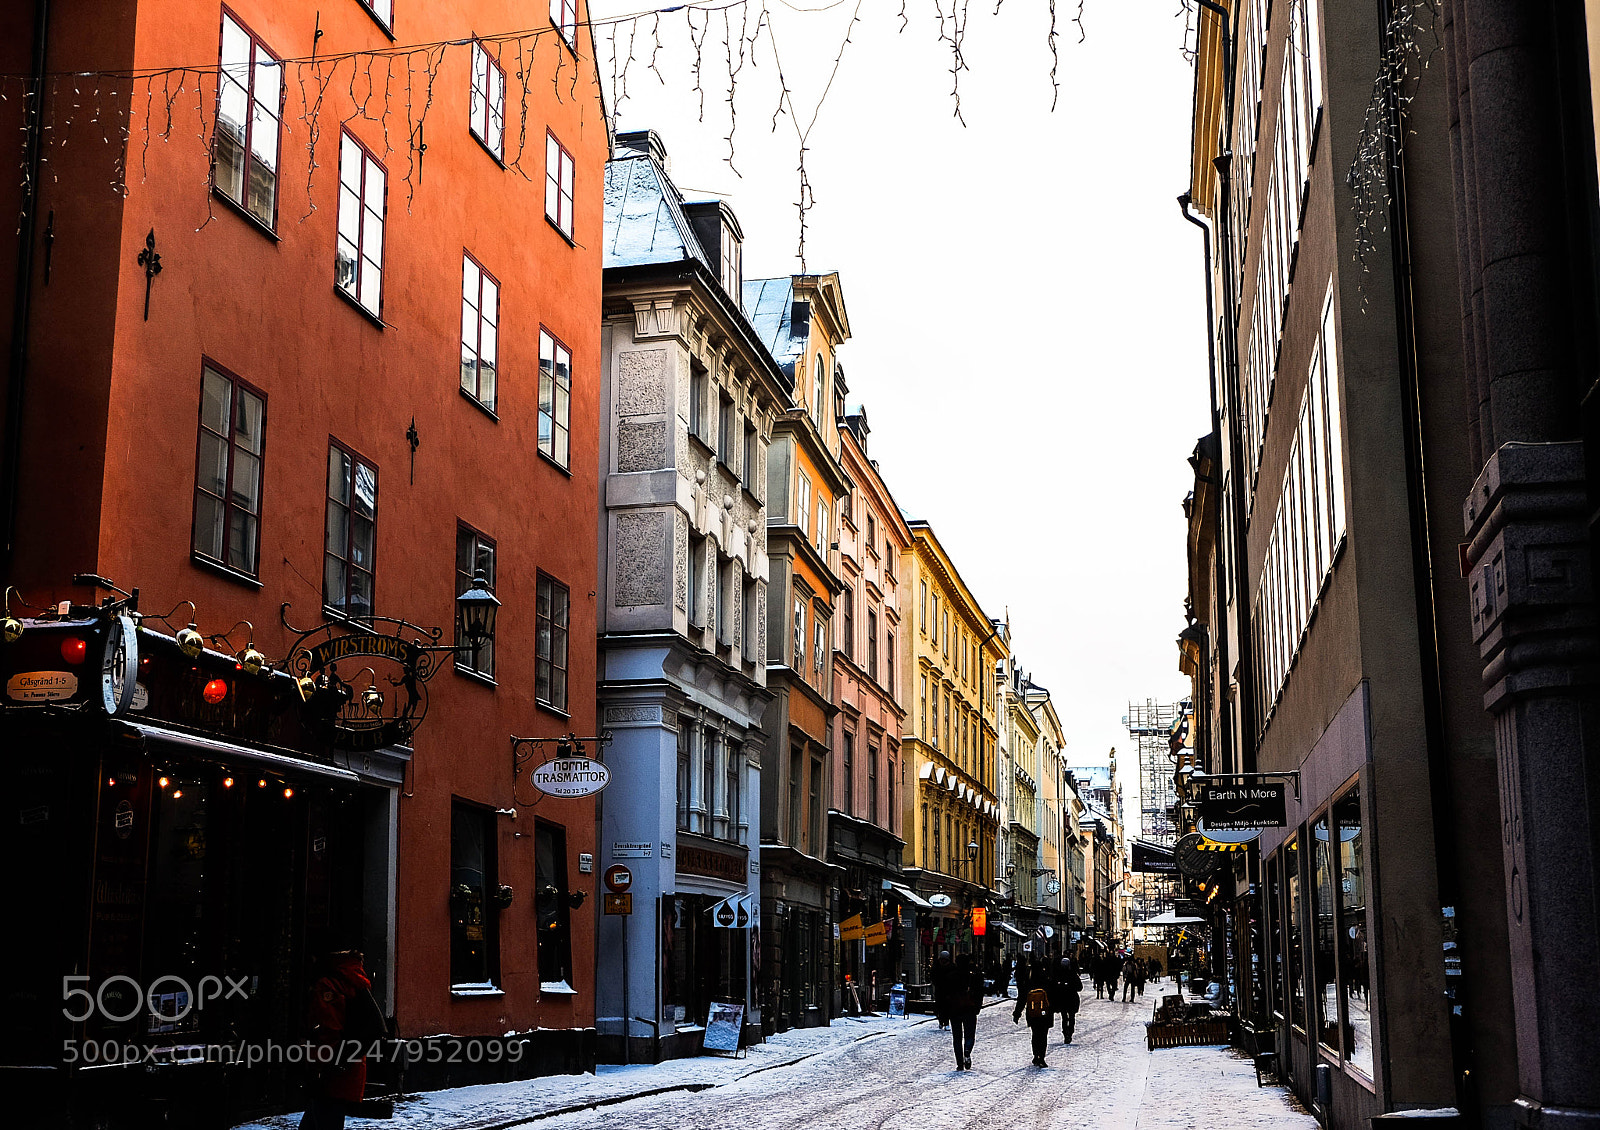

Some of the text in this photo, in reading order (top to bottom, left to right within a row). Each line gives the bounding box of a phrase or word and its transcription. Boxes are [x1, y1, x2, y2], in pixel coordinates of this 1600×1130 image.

[535, 771, 606, 783] TRASMATTOR
[1208, 788, 1277, 801] Earth N More
